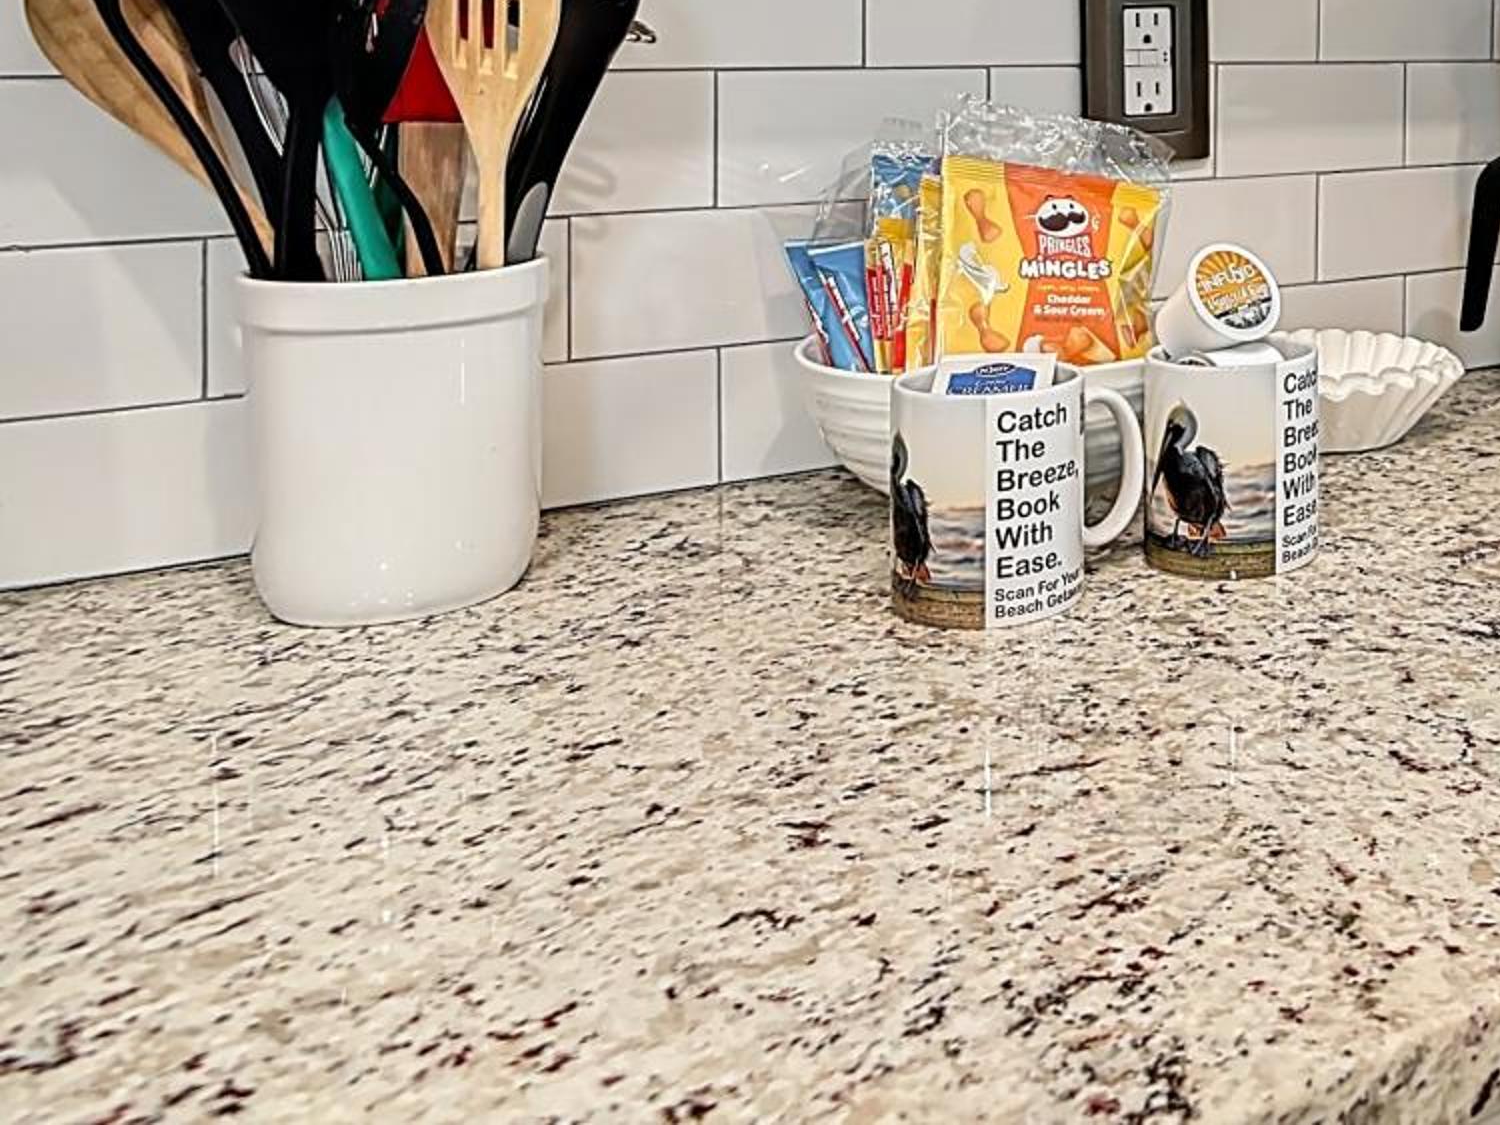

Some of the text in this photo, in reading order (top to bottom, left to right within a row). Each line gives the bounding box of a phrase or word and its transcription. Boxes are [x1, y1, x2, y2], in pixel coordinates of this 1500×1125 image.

[1038, 235, 1092, 258] PRINGLES
[1043, 305, 1068, 315] Sour
[1070, 306, 1105, 316] Cream
[1047, 294, 1091, 304] Cheddar
[997, 402, 1067, 434] Catch
[1282, 398, 1313, 420] The
[995, 438, 1046, 463] The
[997, 460, 1079, 492] Breeze,
[997, 490, 1061, 521] Book
[995, 521, 1053, 550] With
[997, 552, 1063, 579] Ease.
[994, 586, 1035, 602] Scan
[1038, 578, 1060, 595] For
[994, 599, 1043, 618] Beach
